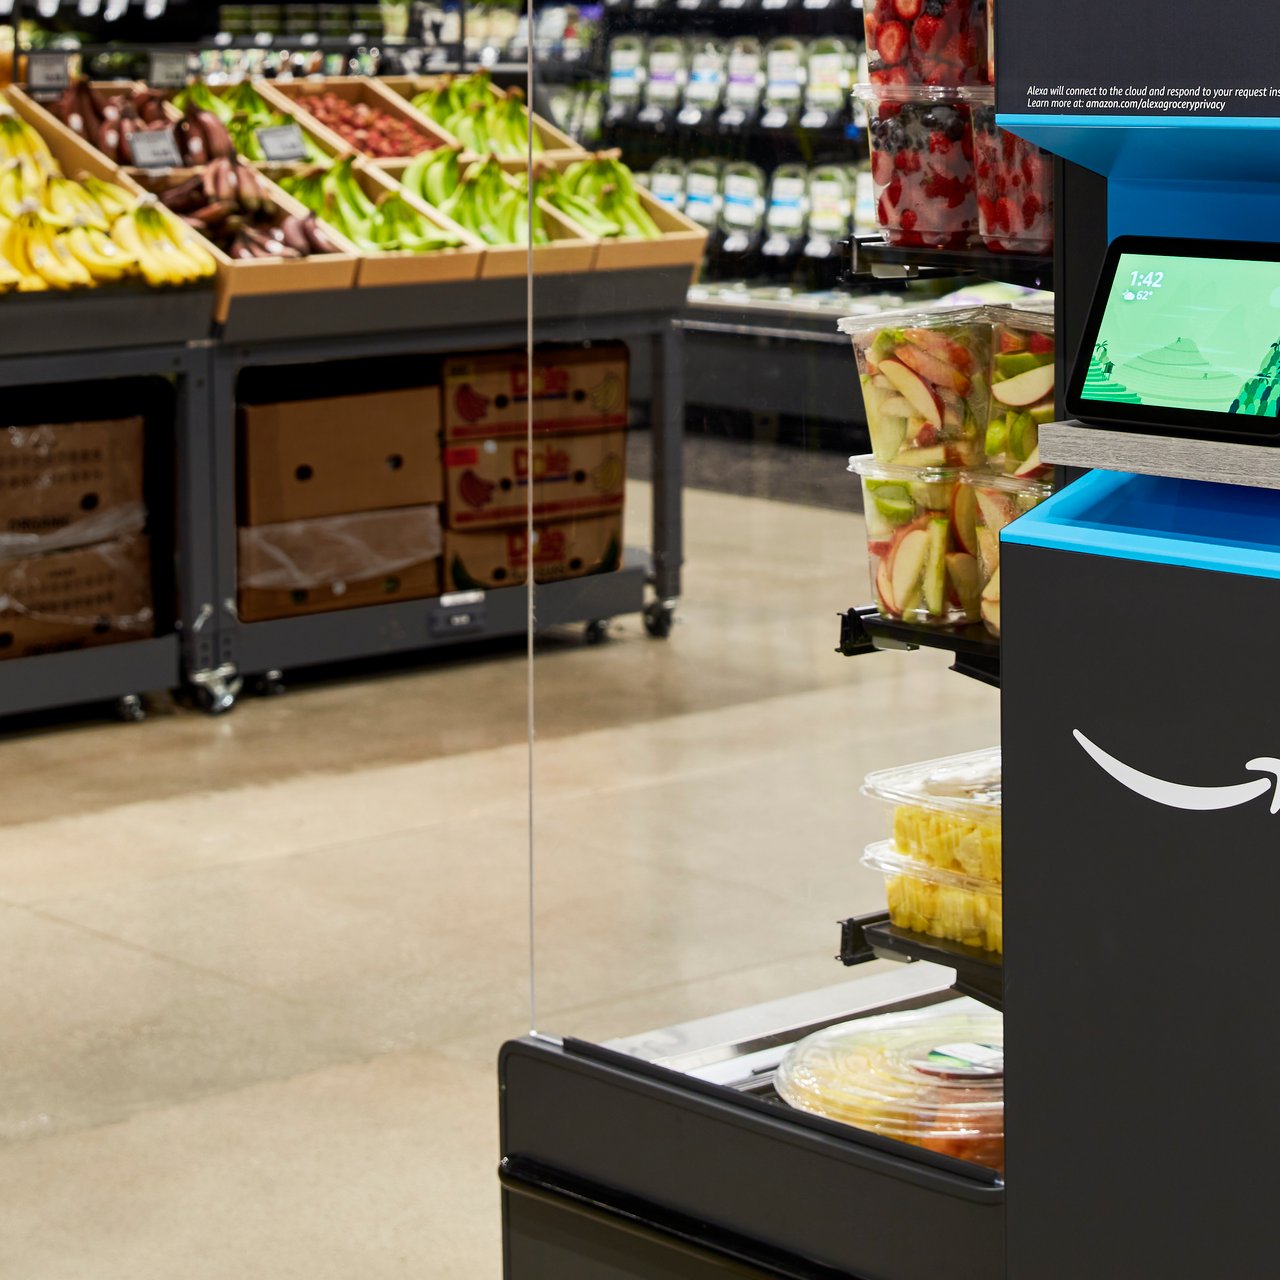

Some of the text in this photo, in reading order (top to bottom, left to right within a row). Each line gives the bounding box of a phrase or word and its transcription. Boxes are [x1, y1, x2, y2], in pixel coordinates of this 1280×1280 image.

[1027, 86, 1048, 95] Alexa
[1050, 86, 1064, 95] will
[1066, 87, 1096, 96] connect
[1099, 87, 1107, 95] to
[1110, 86, 1123, 95] the
[1125, 86, 1147, 96] cloud
[1149, 86, 1165, 96] and
[1167, 87, 1200, 98] respond
[1203, 88, 1211, 96] to
[1213, 89, 1233, 98] your
[1235, 88, 1266, 99] request
[1027, 99, 1049, 108] Learn
[1073, 100, 1084, 108] at:
[1086, 99, 1225, 111] amazon.com/alexagroceryprivacy
[1130, 270, 1164, 288] 1:42
[1136, 290, 1153, 300] 62°
